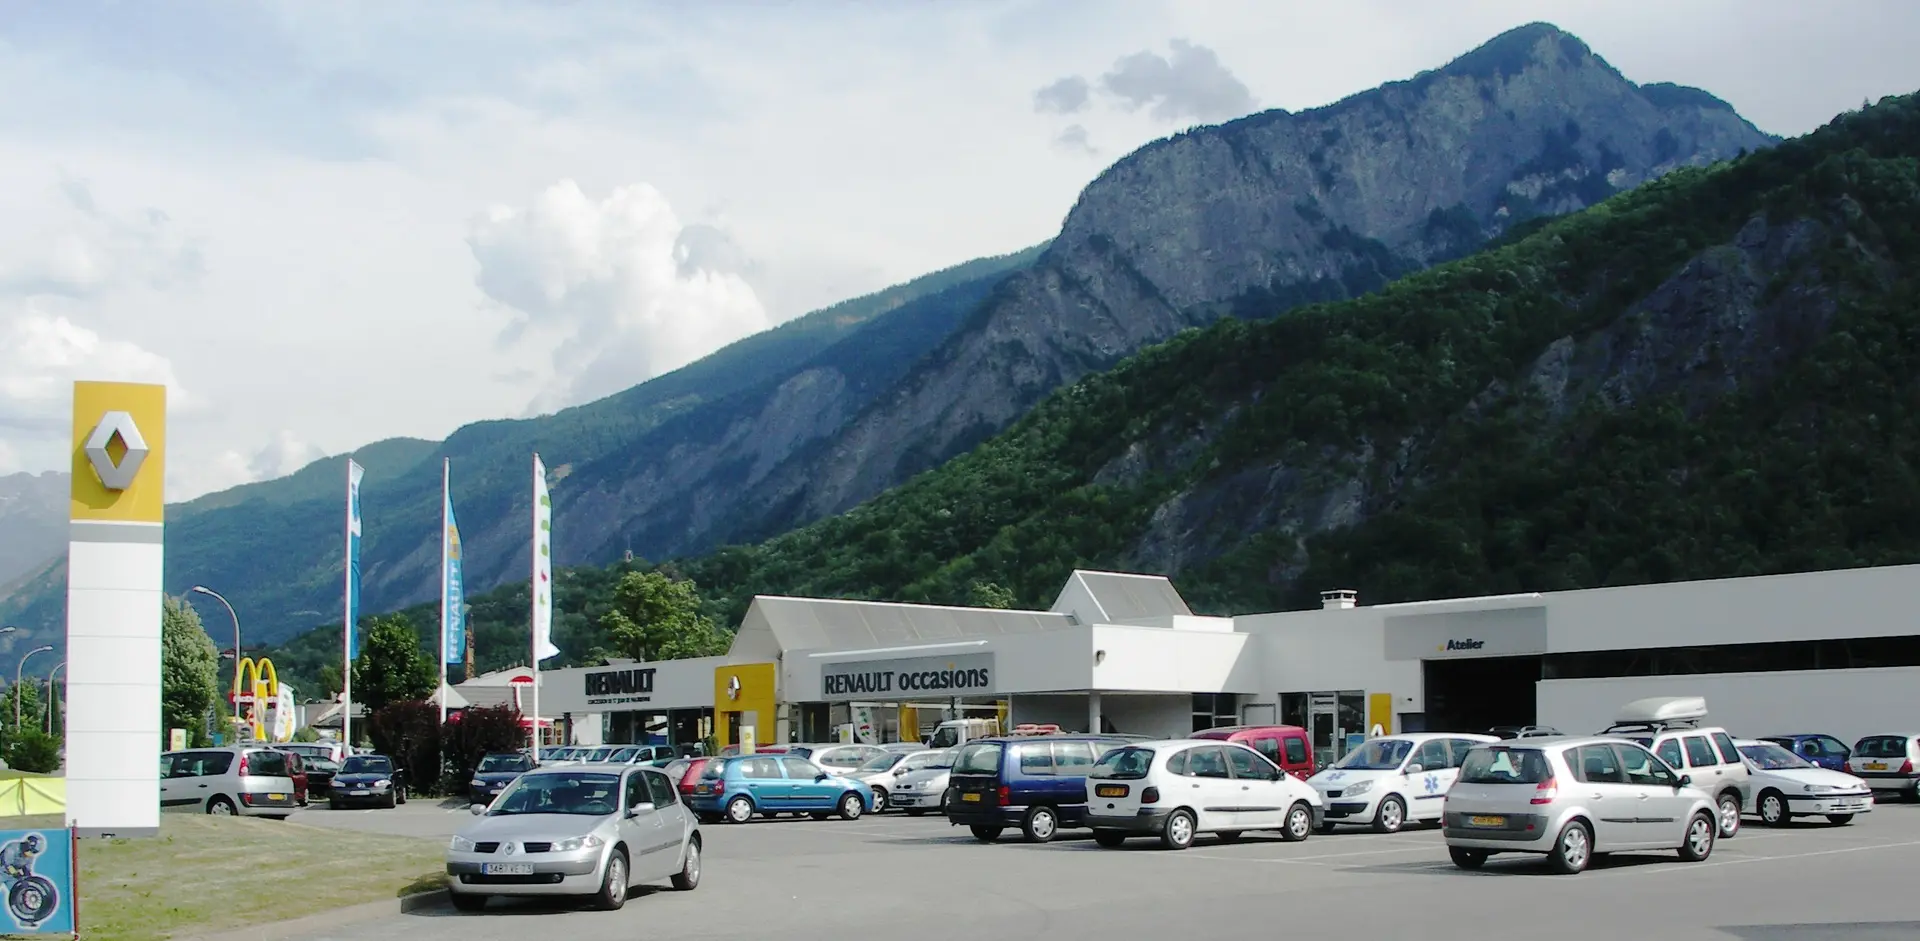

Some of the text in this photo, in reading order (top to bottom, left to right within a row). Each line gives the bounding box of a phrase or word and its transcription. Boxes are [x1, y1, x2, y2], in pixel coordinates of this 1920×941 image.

[1446, 638, 1484, 650] Atelier
[585, 668, 656, 695] RENAULT
[824, 662, 988, 694] RENAULT occasions
